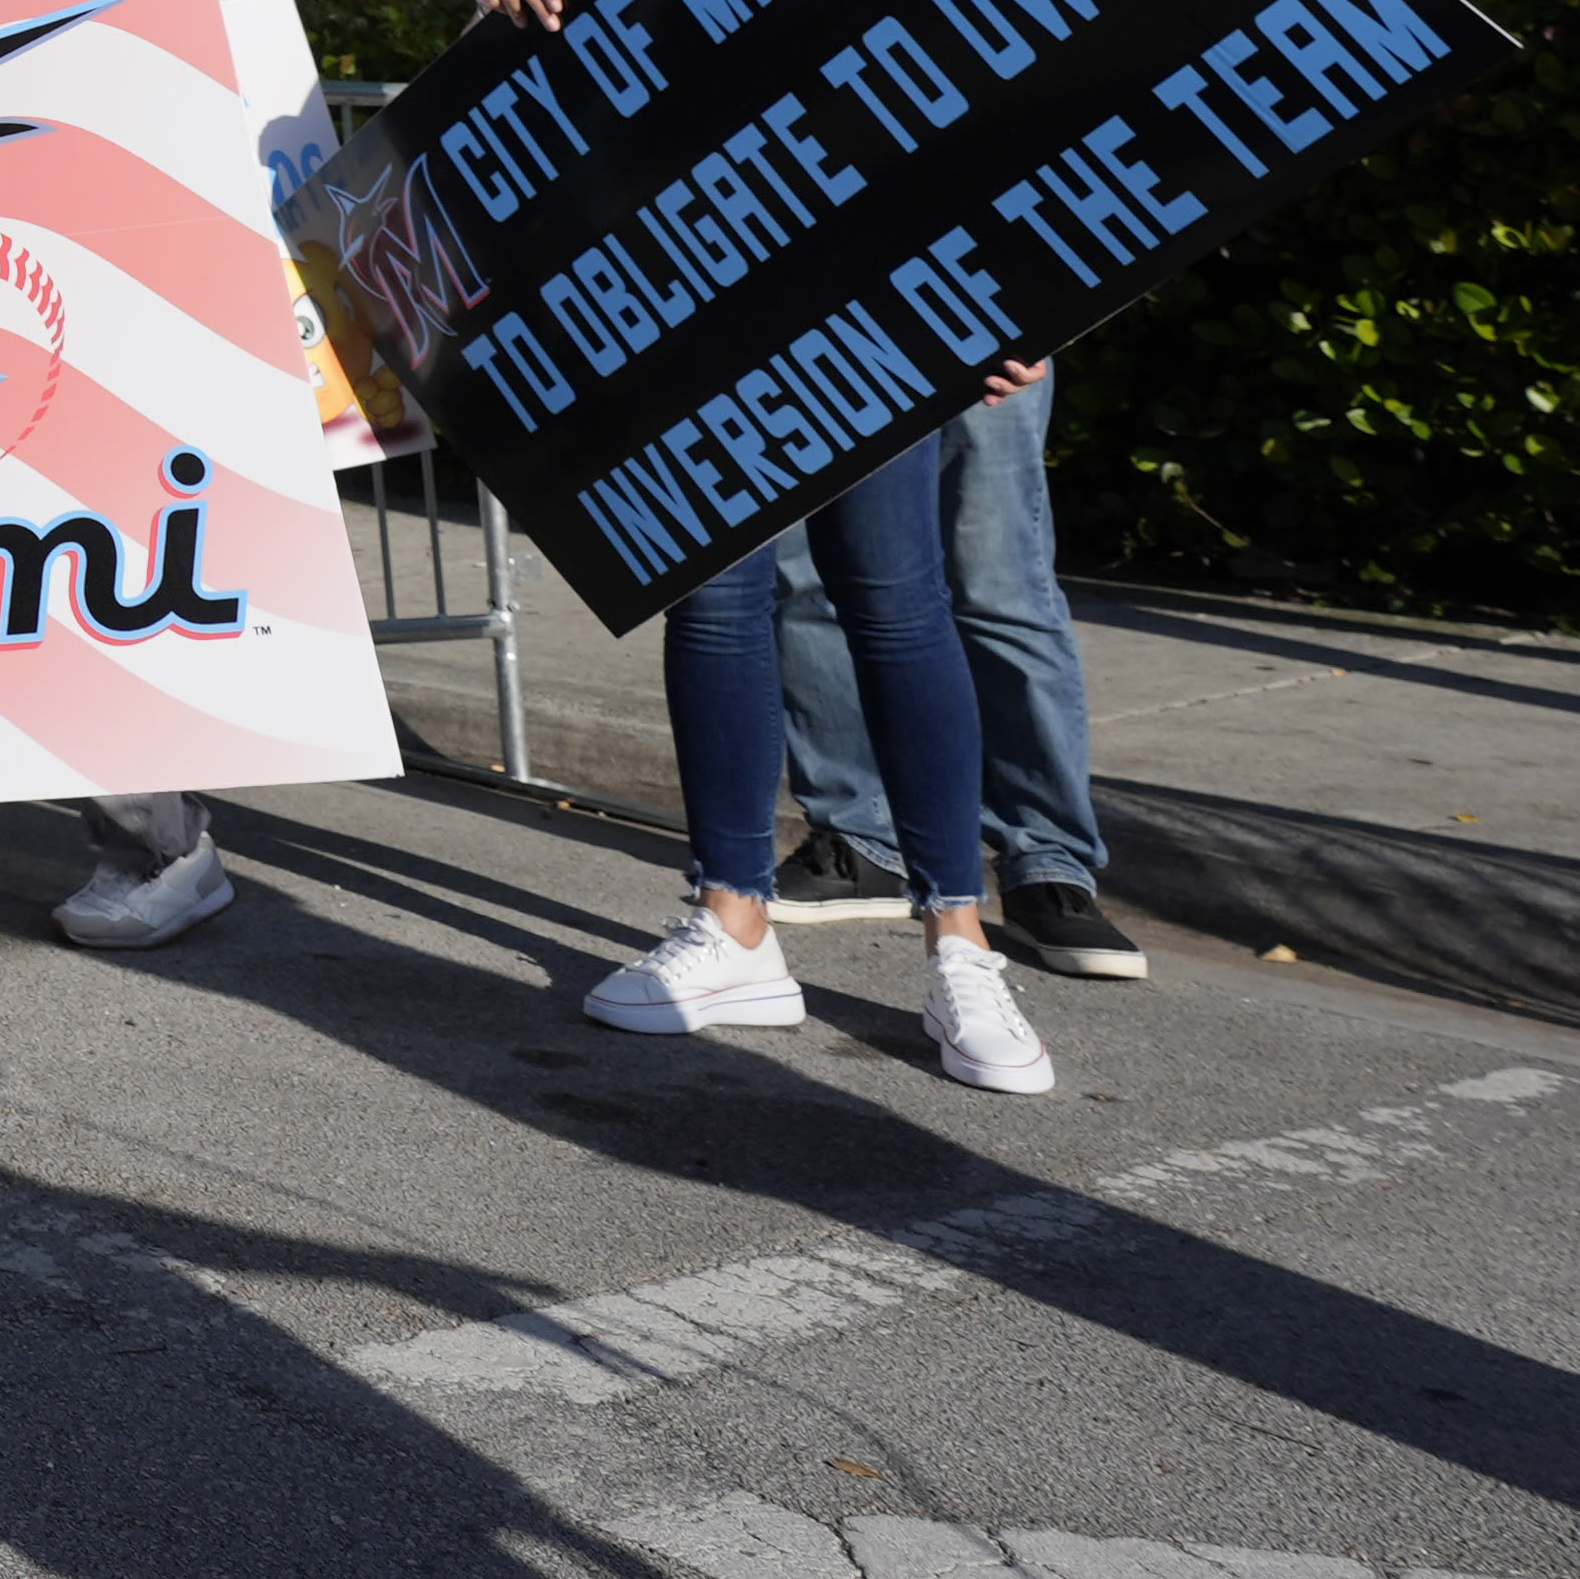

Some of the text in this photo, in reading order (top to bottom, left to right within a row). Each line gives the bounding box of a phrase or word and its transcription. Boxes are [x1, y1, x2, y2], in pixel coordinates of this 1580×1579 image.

[441, 57, 589, 221] CITY
[464, 313, 575, 430] TO
[541, 94, 866, 376] OBLIGATE
[821, 17, 968, 152] TO
[580, 300, 935, 583] INVERSION
[890, 228, 1021, 365] OF
[993, 116, 1206, 287] THE
